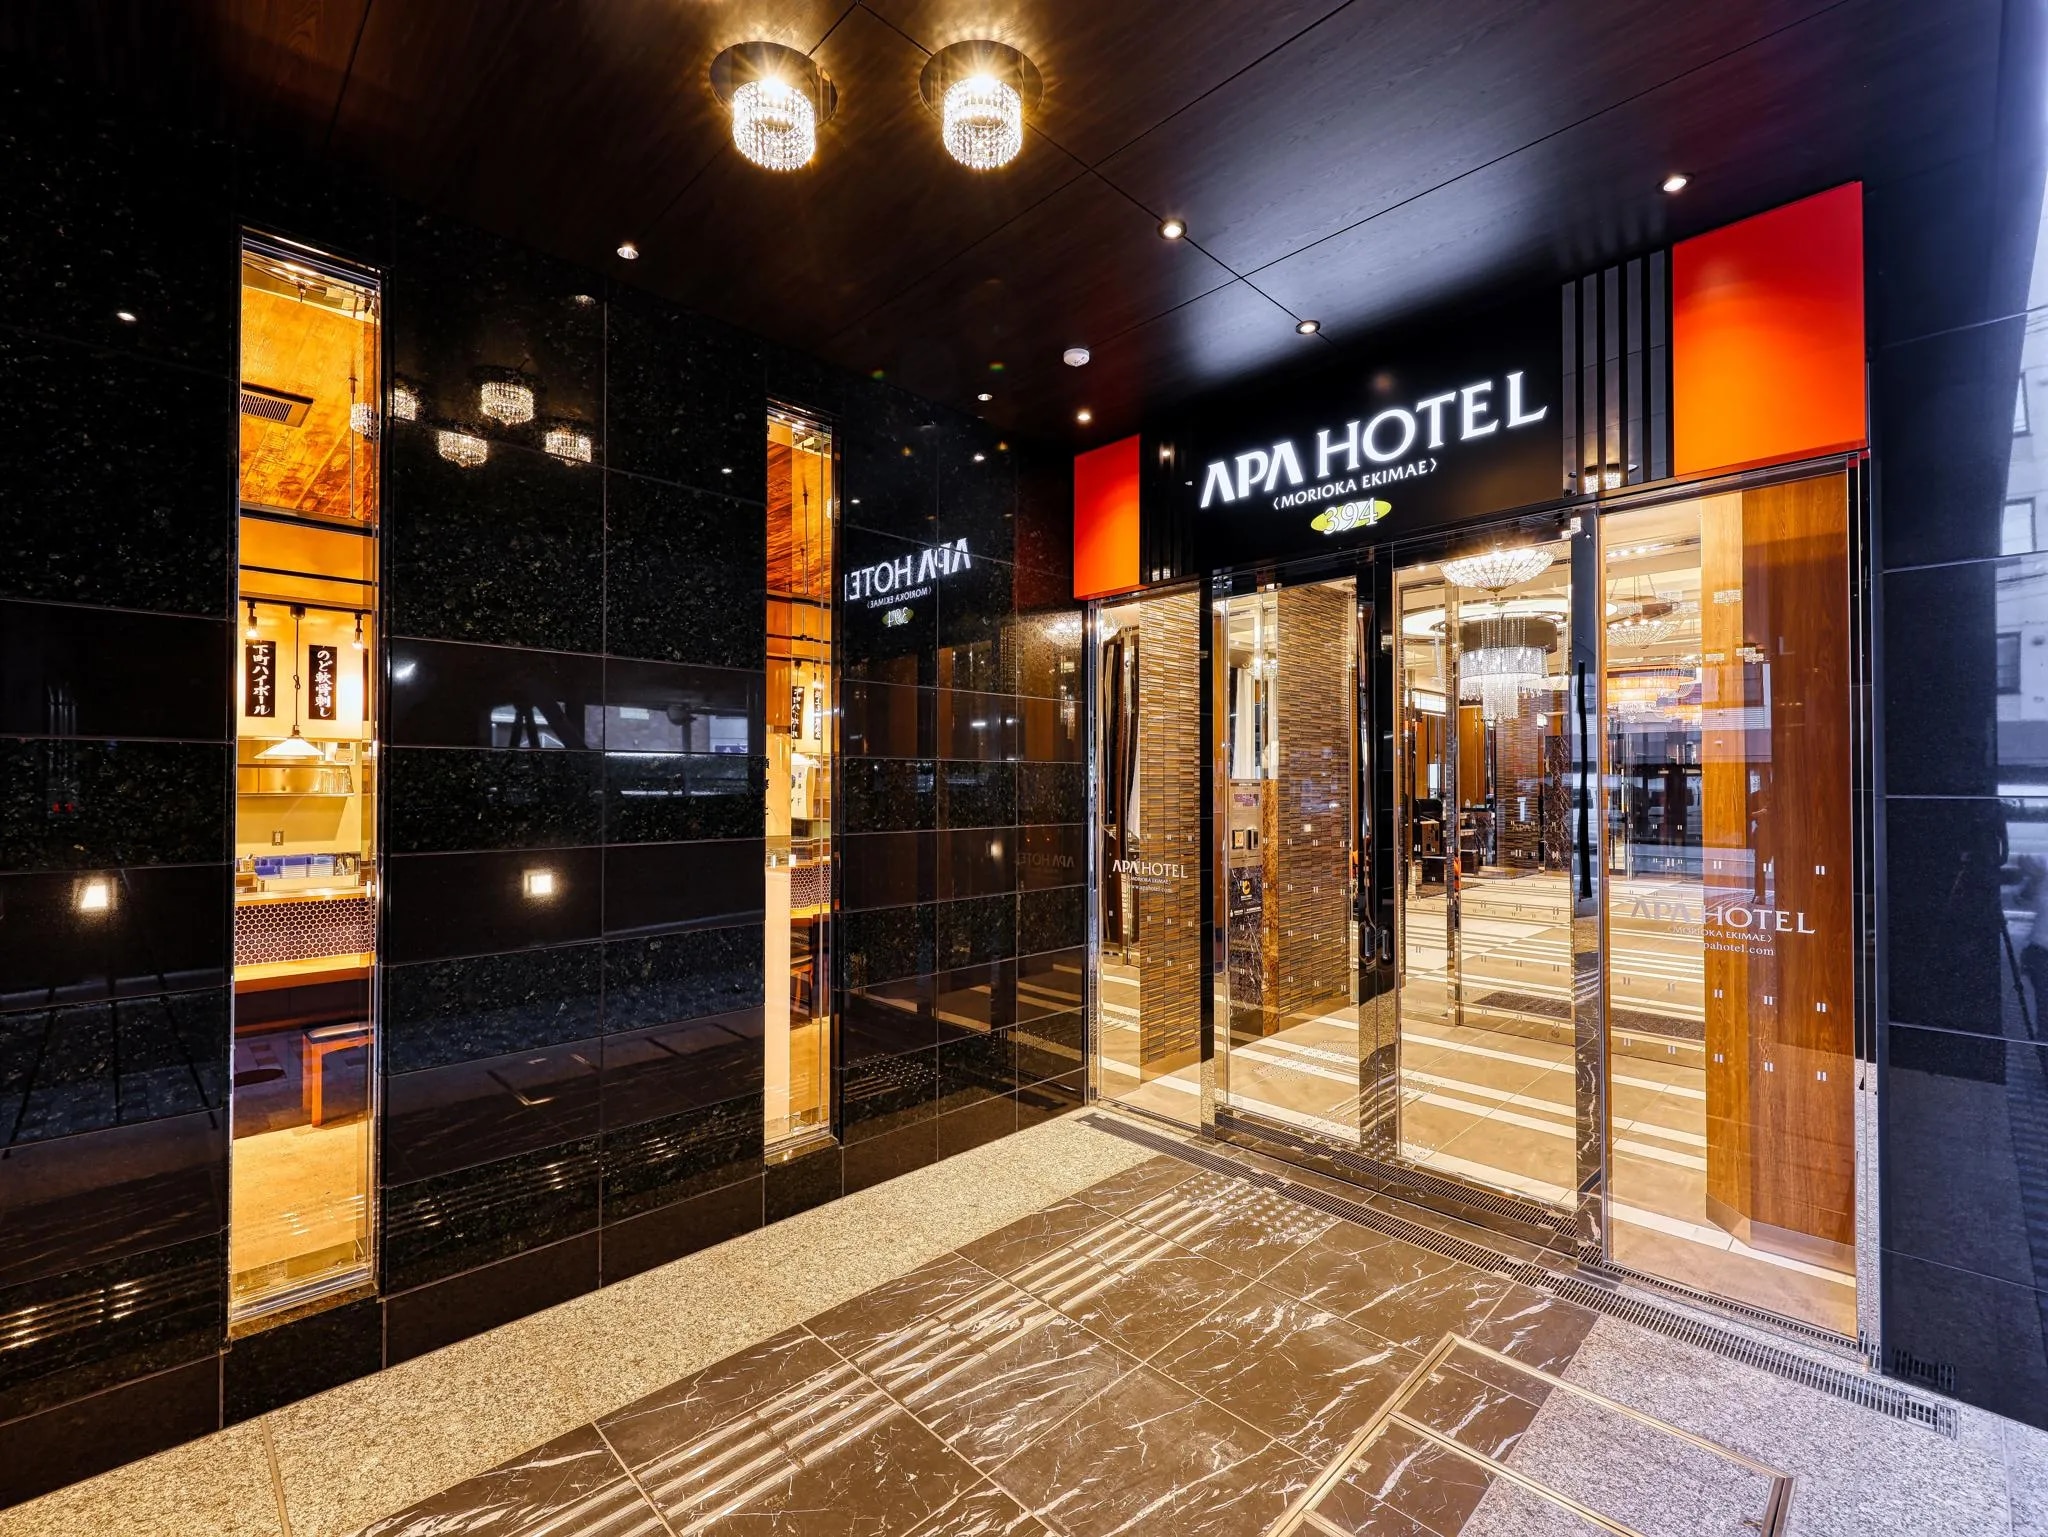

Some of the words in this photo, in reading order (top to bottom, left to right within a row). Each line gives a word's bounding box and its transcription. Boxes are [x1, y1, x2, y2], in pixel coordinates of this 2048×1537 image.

[1200, 440, 1304, 509] APA
[1316, 370, 1549, 480] HOTEL
[1323, 497, 1379, 535] 394
[252, 644, 270, 716] 下町ハイボール
[315, 650, 333, 718] のど軟骨刺し
[1112, 859, 1139, 875] APA
[1141, 861, 1189, 879] HOTEL
[1631, 896, 1692, 924] APA
[1703, 905, 1816, 935] HOTEL
